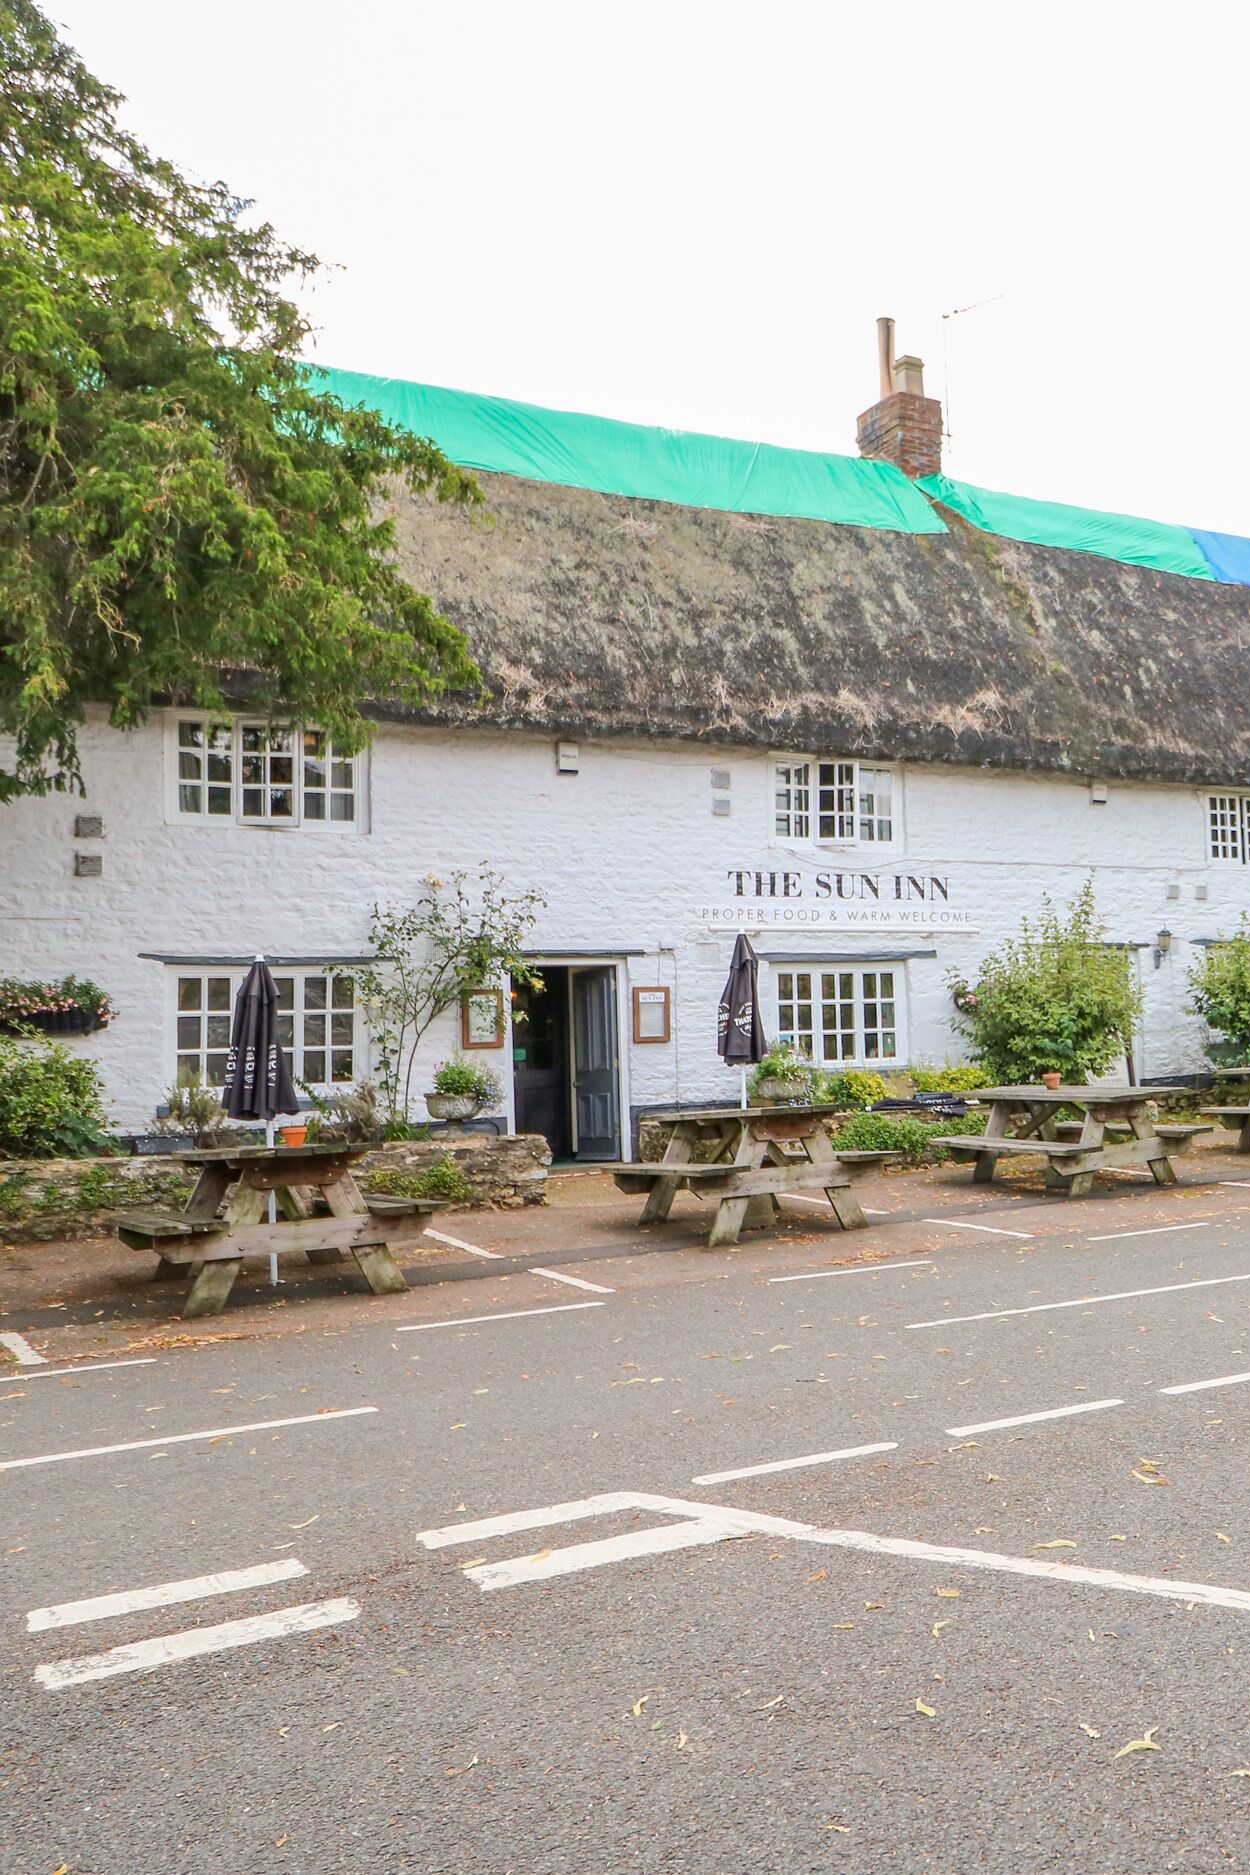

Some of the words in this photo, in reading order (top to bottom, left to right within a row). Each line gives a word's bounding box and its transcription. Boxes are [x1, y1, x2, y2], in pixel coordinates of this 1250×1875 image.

[727, 871, 802, 898] THE
[815, 872, 881, 900] SUN
[893, 874, 951, 901] INN
[702, 908, 765, 921] PROPER
[774, 909, 820, 921] FOOD
[829, 910, 838, 921] &
[847, 911, 891, 921] WARM
[898, 911, 971, 923] WELCOME
